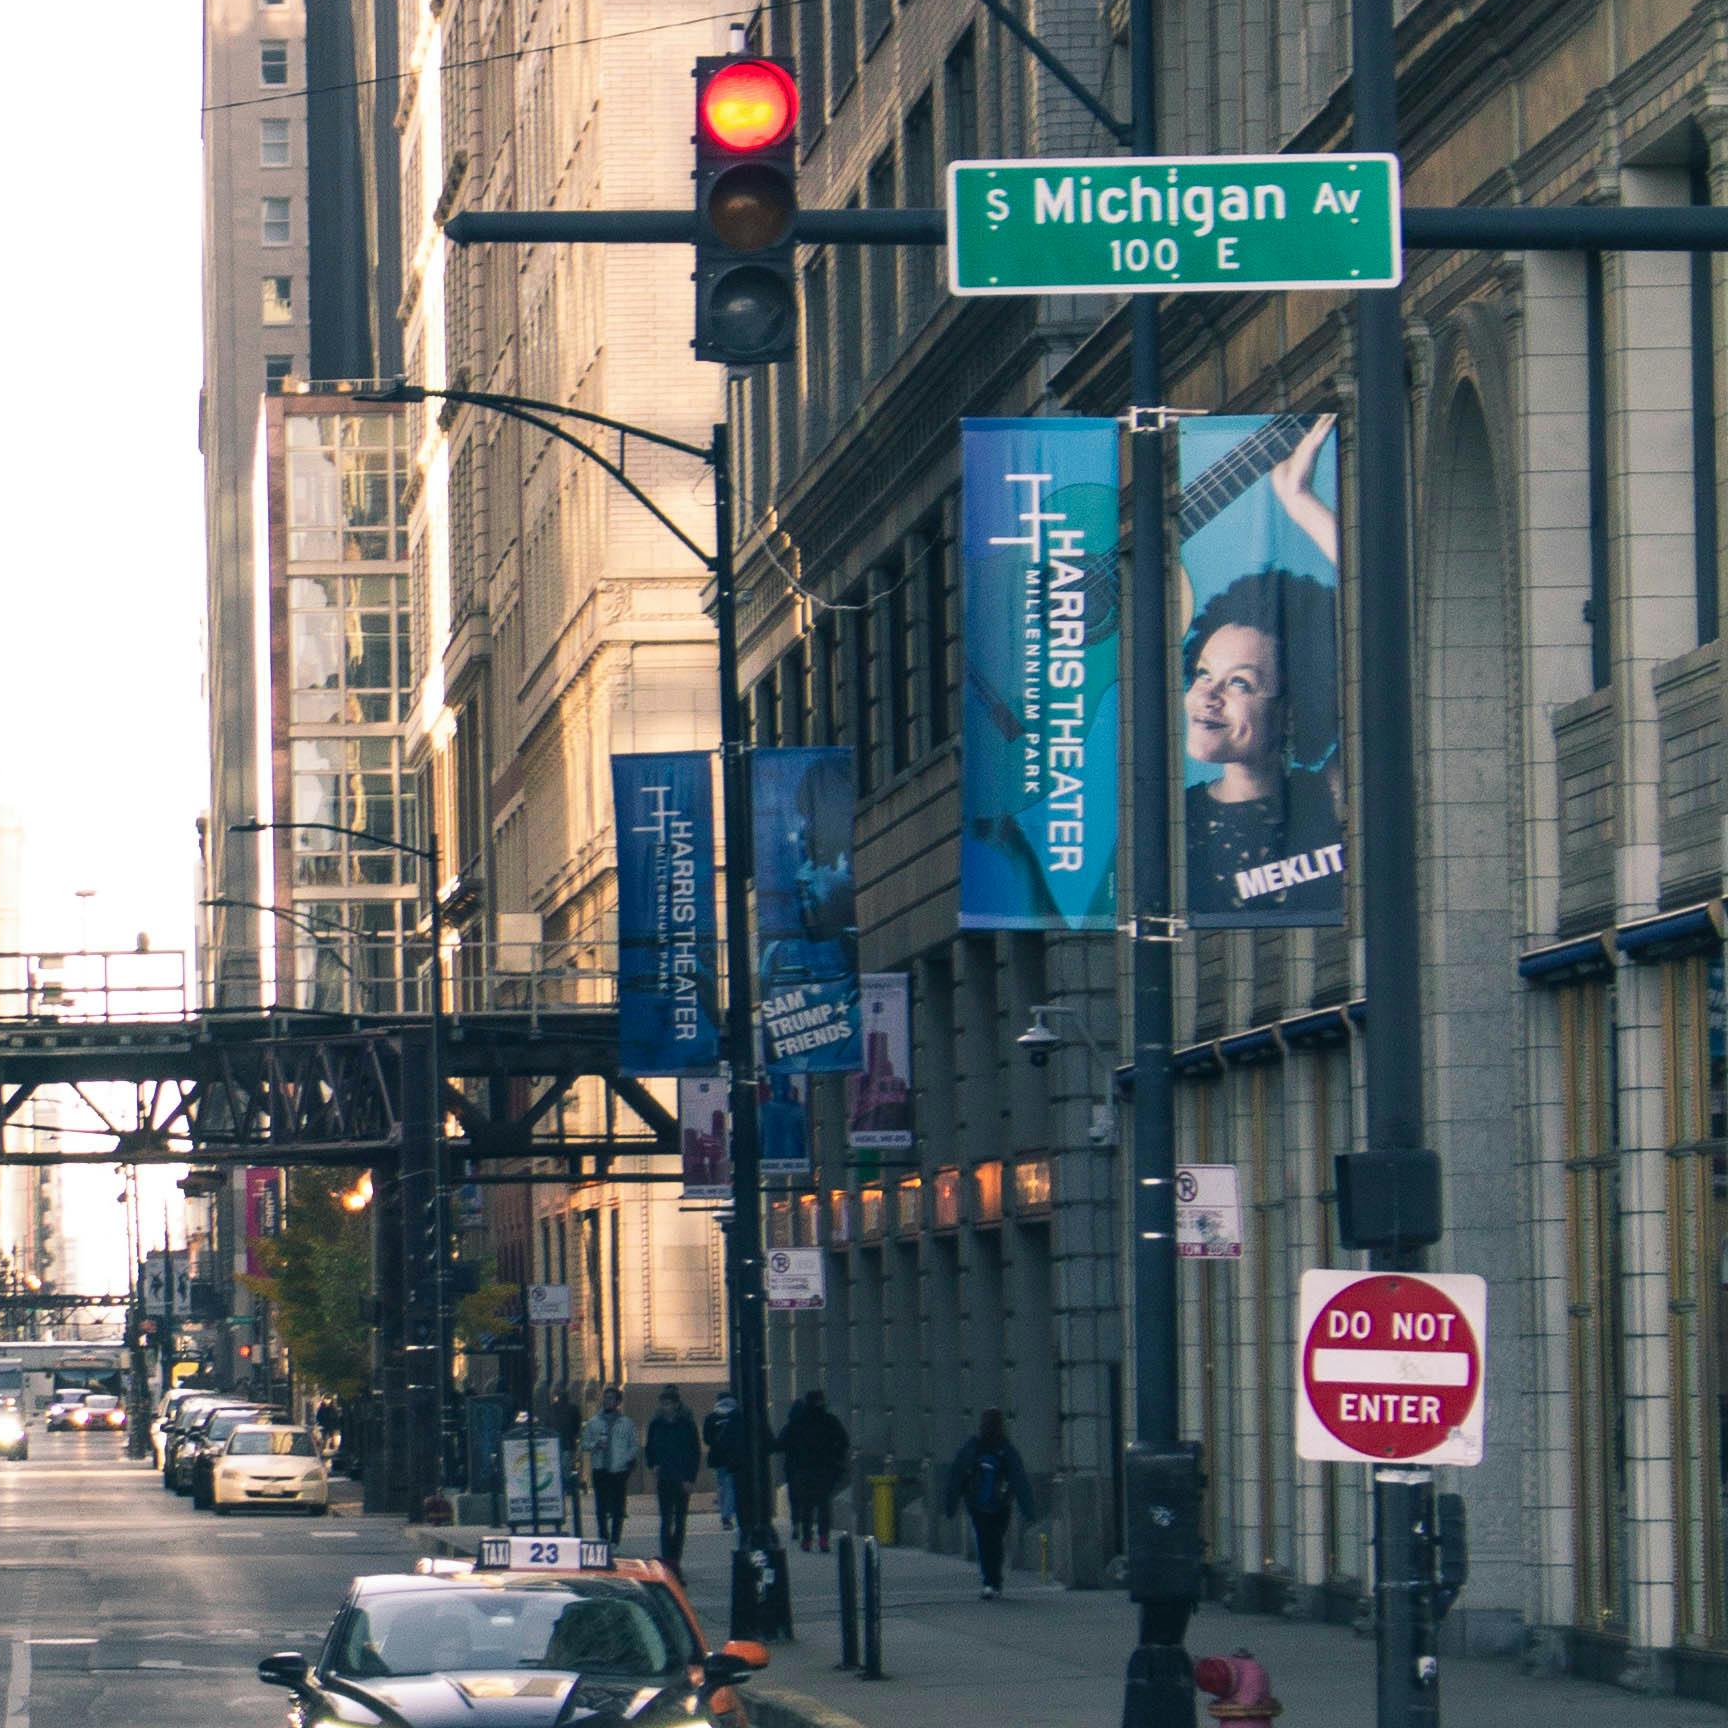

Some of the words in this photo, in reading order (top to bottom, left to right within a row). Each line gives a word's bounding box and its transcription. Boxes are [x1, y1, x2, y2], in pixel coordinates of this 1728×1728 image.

[986, 188, 1010, 222] S
[1034, 174, 1286, 237] Michigan
[1312, 182, 1361, 214] Av
[1110, 238, 1179, 272] 100
[1217, 237, 1240, 270] E
[1048, 529, 1085, 689] HARRIS
[1024, 569, 1040, 721] MILLENNIUM
[1024, 733, 1040, 795] PARK
[1049, 698, 1085, 873] THEATER
[671, 821, 697, 924] HARRIS
[1235, 843, 1344, 900] MEKLIT
[655, 844, 670, 945] MILLENNIUM
[658, 951, 670, 992] PARK
[674, 926, 698, 1041] THEATER
[761, 990, 806, 1019] SAM
[767, 1003, 833, 1038] TRUMP
[773, 1020, 853, 1060] FRIENDS
[1329, 1310, 1371, 1340] DO
[1391, 1311, 1456, 1341] NOT
[1340, 1393, 1441, 1424] ENTER
[482, 1542, 510, 1565] TAXI
[529, 1542, 559, 1564] 23
[581, 1543, 608, 1566] TAXI
